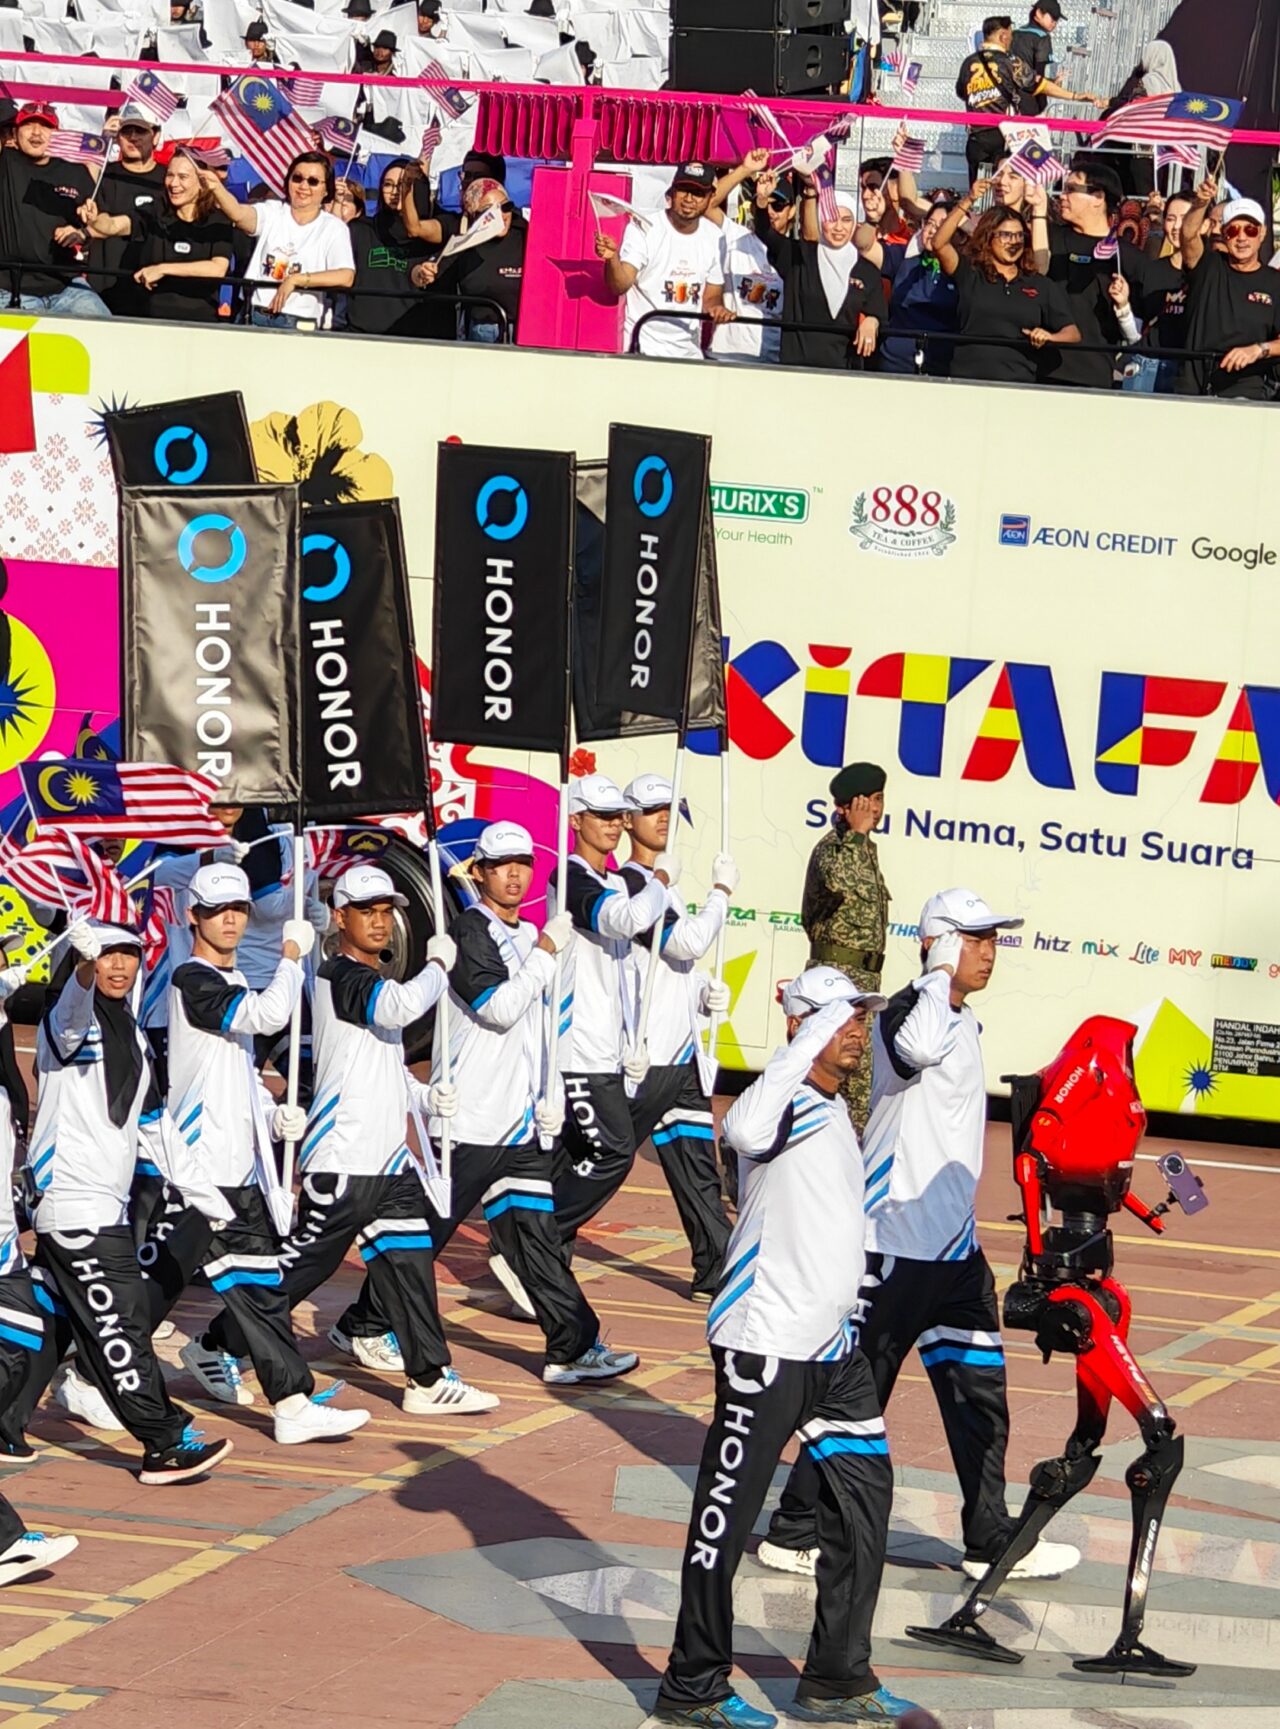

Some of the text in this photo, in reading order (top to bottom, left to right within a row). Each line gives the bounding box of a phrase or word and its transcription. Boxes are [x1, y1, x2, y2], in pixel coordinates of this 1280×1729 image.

[871, 485, 942, 527] 888
[714, 528, 793, 547] Your Health
[872, 531, 888, 543] TEA
[900, 536, 934, 547] COFFEE
[1096, 532, 1178, 556] CREDIT
[1191, 537, 1278, 570] Google
[630, 534, 660, 688] HONOR
[484, 558, 514, 721] HONOR
[195, 603, 233, 787] HONOR
[309, 619, 363, 791] HONOR
[806, 799, 1254, 870] Su Nama, Satu Suara
[726, 906, 756, 921] RA
[1033, 932, 1071, 953] hitz
[1081, 939, 1119, 957] mix
[1128, 941, 1160, 964] Lite
[1168, 948, 1202, 967] MY
[1216, 1020, 1251, 1031] HANDAL
[1054, 1066, 1085, 1104] HONOR
[70, 1258, 140, 1396] HONOR
[689, 1402, 755, 1571] HONOR
